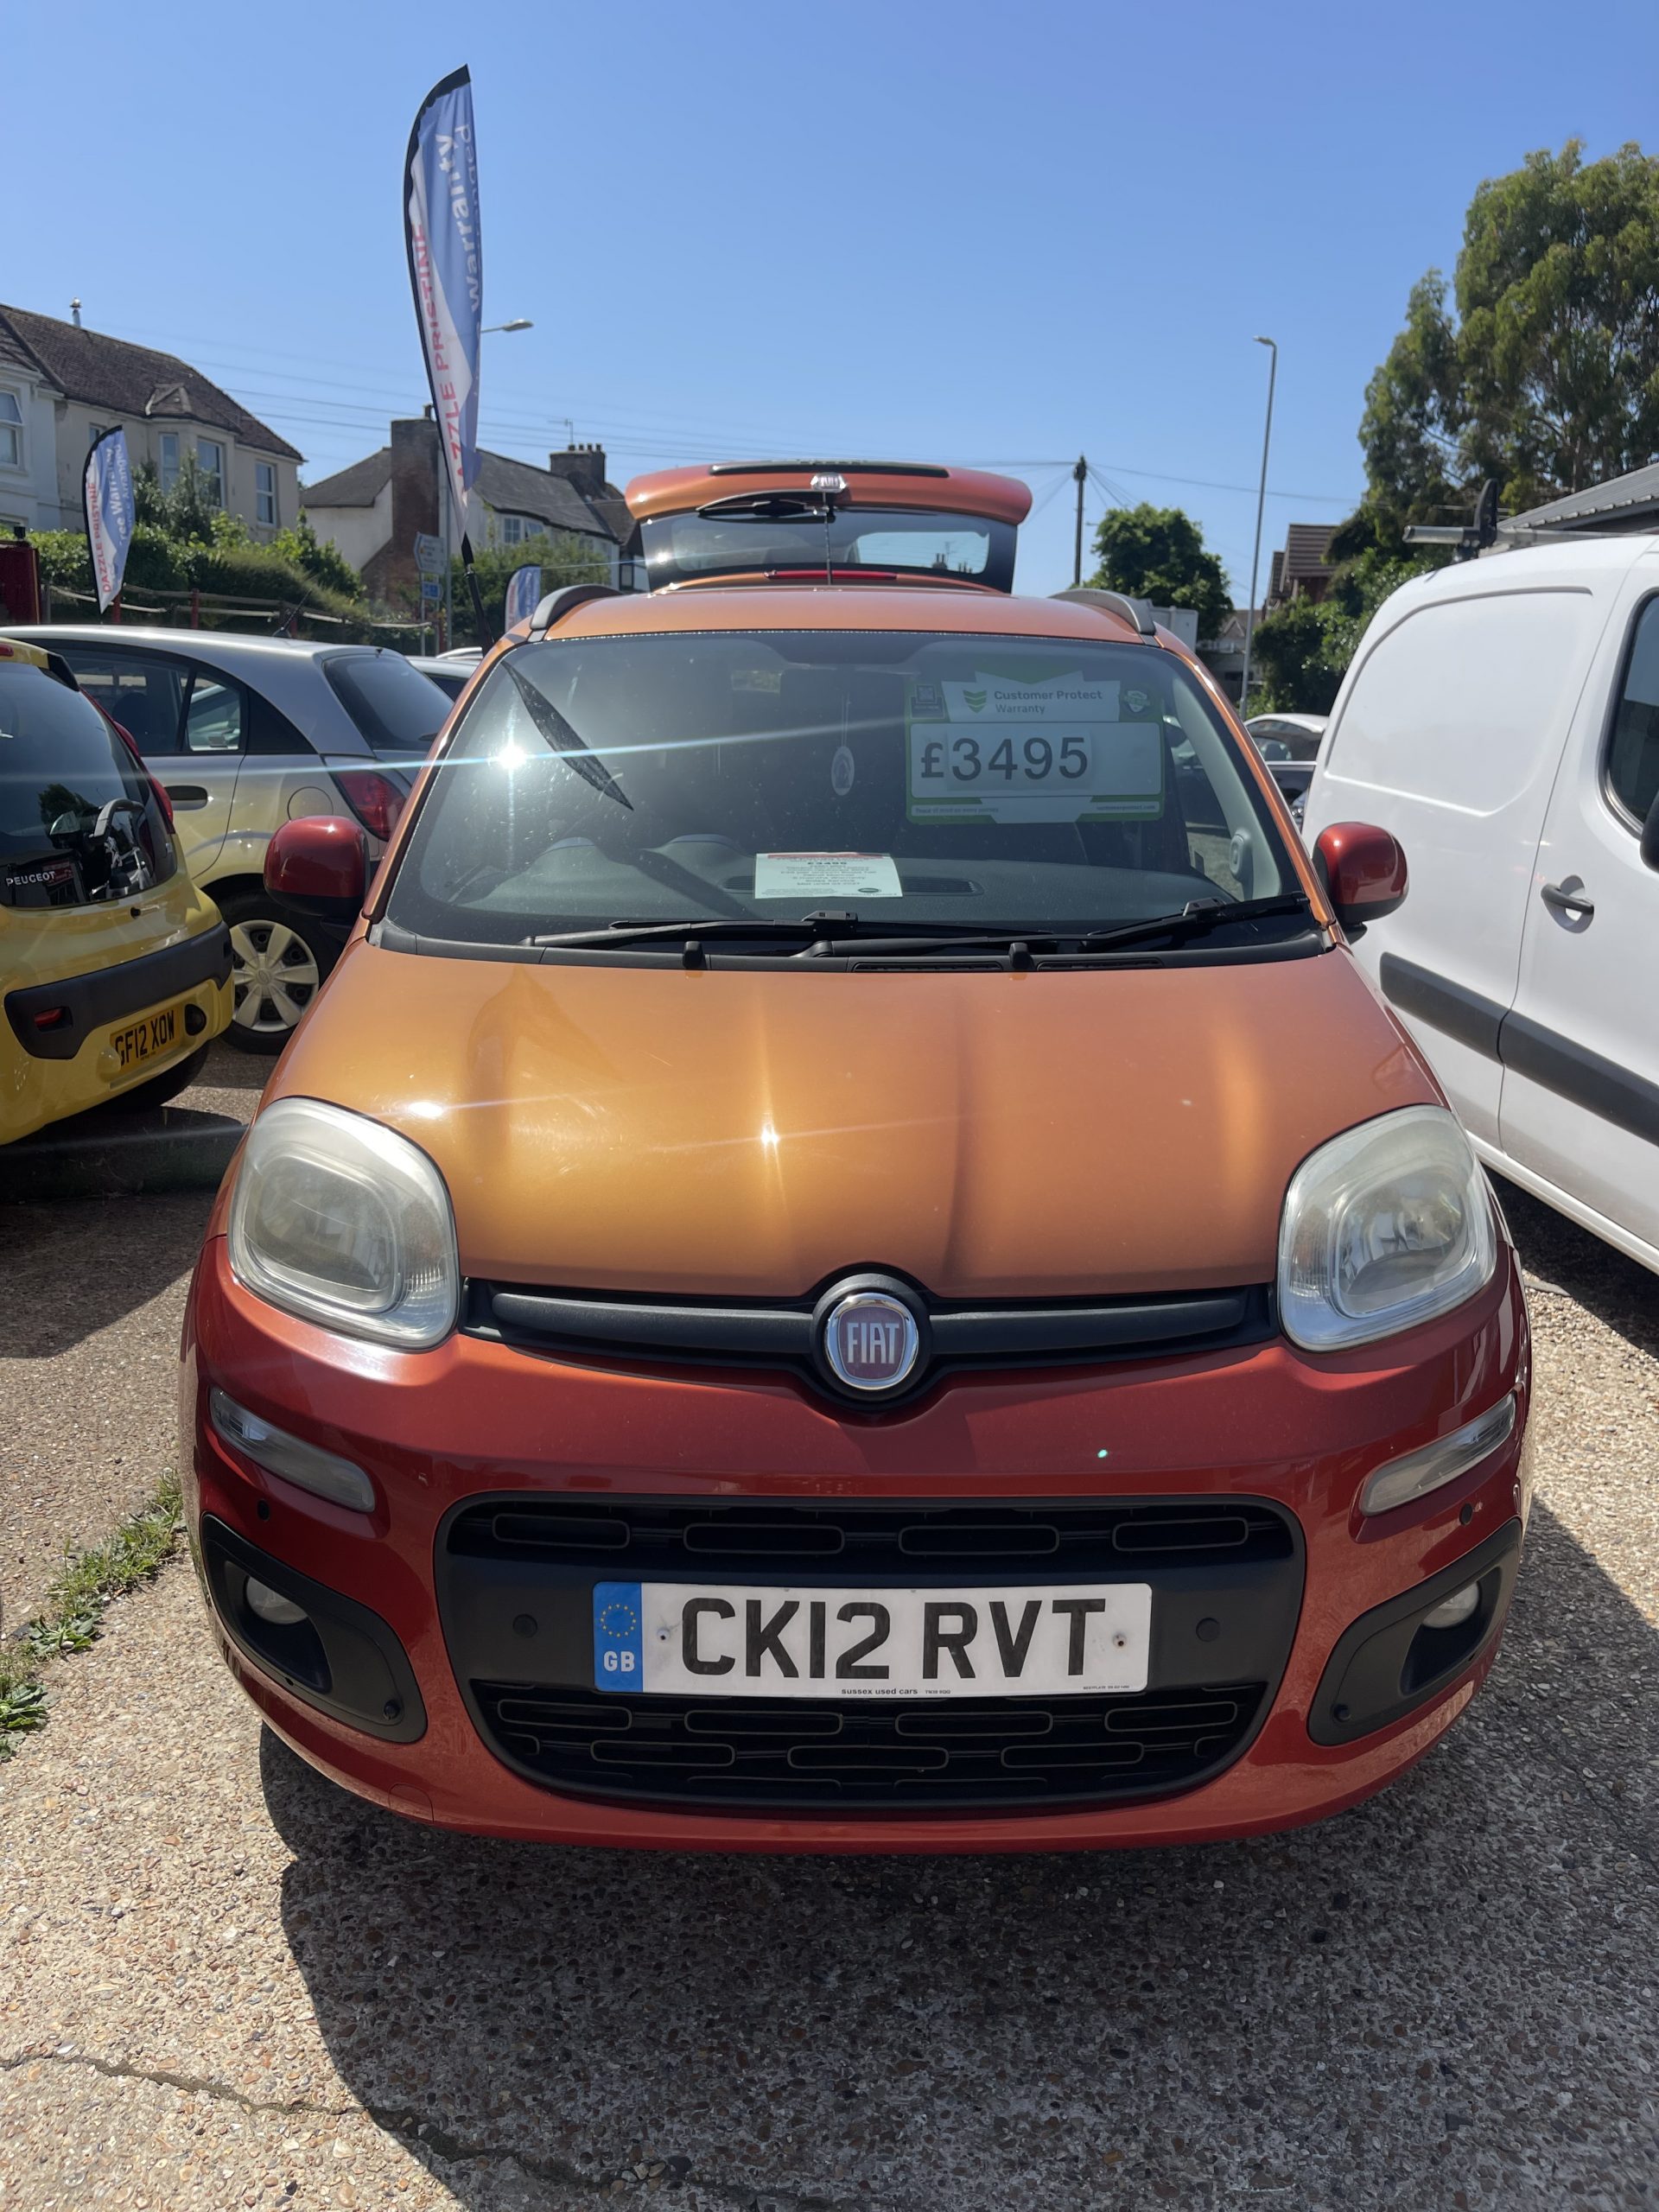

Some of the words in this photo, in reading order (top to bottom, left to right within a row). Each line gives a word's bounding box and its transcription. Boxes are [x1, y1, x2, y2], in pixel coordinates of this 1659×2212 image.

[117, 516, 129, 546] ree
[94, 542, 111, 594] DAZZLE
[994, 690, 1052, 701] Customer
[1056, 689, 1103, 701] Protect
[995, 703, 1046, 715] Warranty
[920, 736, 1089, 781] £3495
[5, 871, 55, 887] PEUGEOT
[114, 1024, 148, 1066] GF12
[149, 1009, 175, 1051] XOW
[846, 1322, 900, 1364] FIAT
[681, 1597, 891, 1680] CK12
[922, 1598, 1106, 1680] RVT
[602, 1651, 635, 1673] GB
